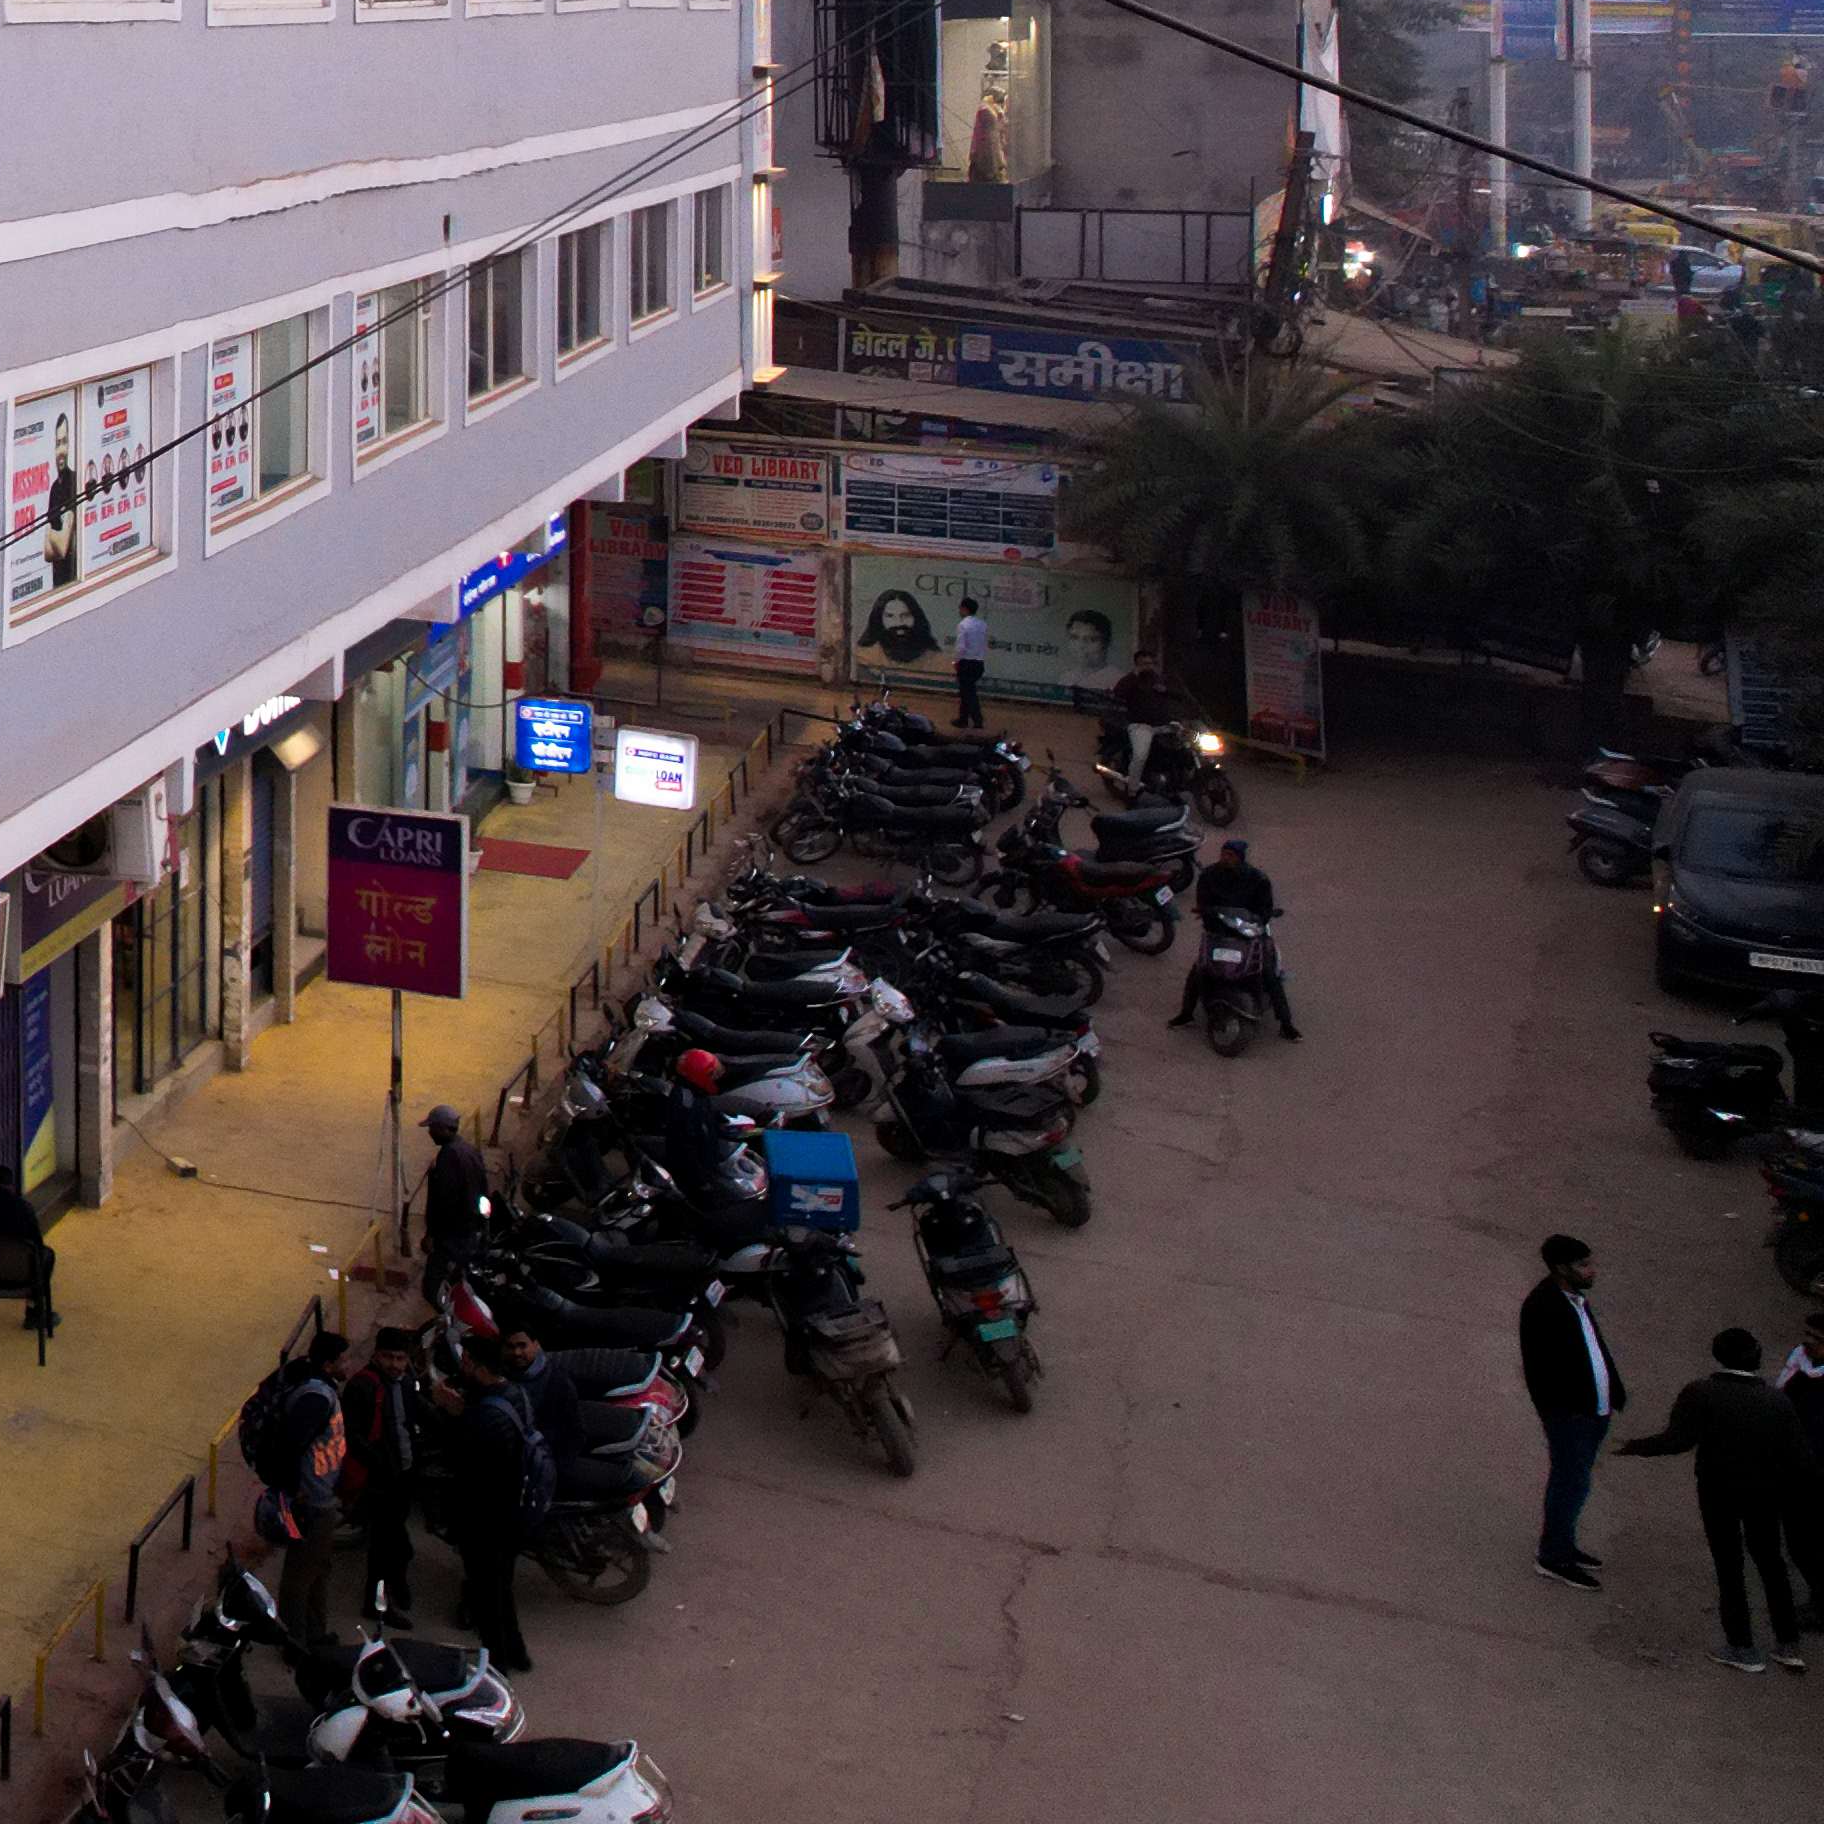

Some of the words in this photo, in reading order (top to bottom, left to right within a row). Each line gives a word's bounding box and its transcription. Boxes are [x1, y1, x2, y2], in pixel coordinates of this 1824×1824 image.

[850, 324, 907, 359] होटल
[998, 341, 1184, 399] समीक्षा
[714, 455, 742, 474] VED
[752, 458, 820, 480] LIBRARY
[656, 770, 682, 782] LOAN
[347, 816, 443, 853] CAPRI
[379, 847, 442, 866] LOANS
[354, 879, 439, 925] गोल्ड
[363, 921, 427, 969] लोन
